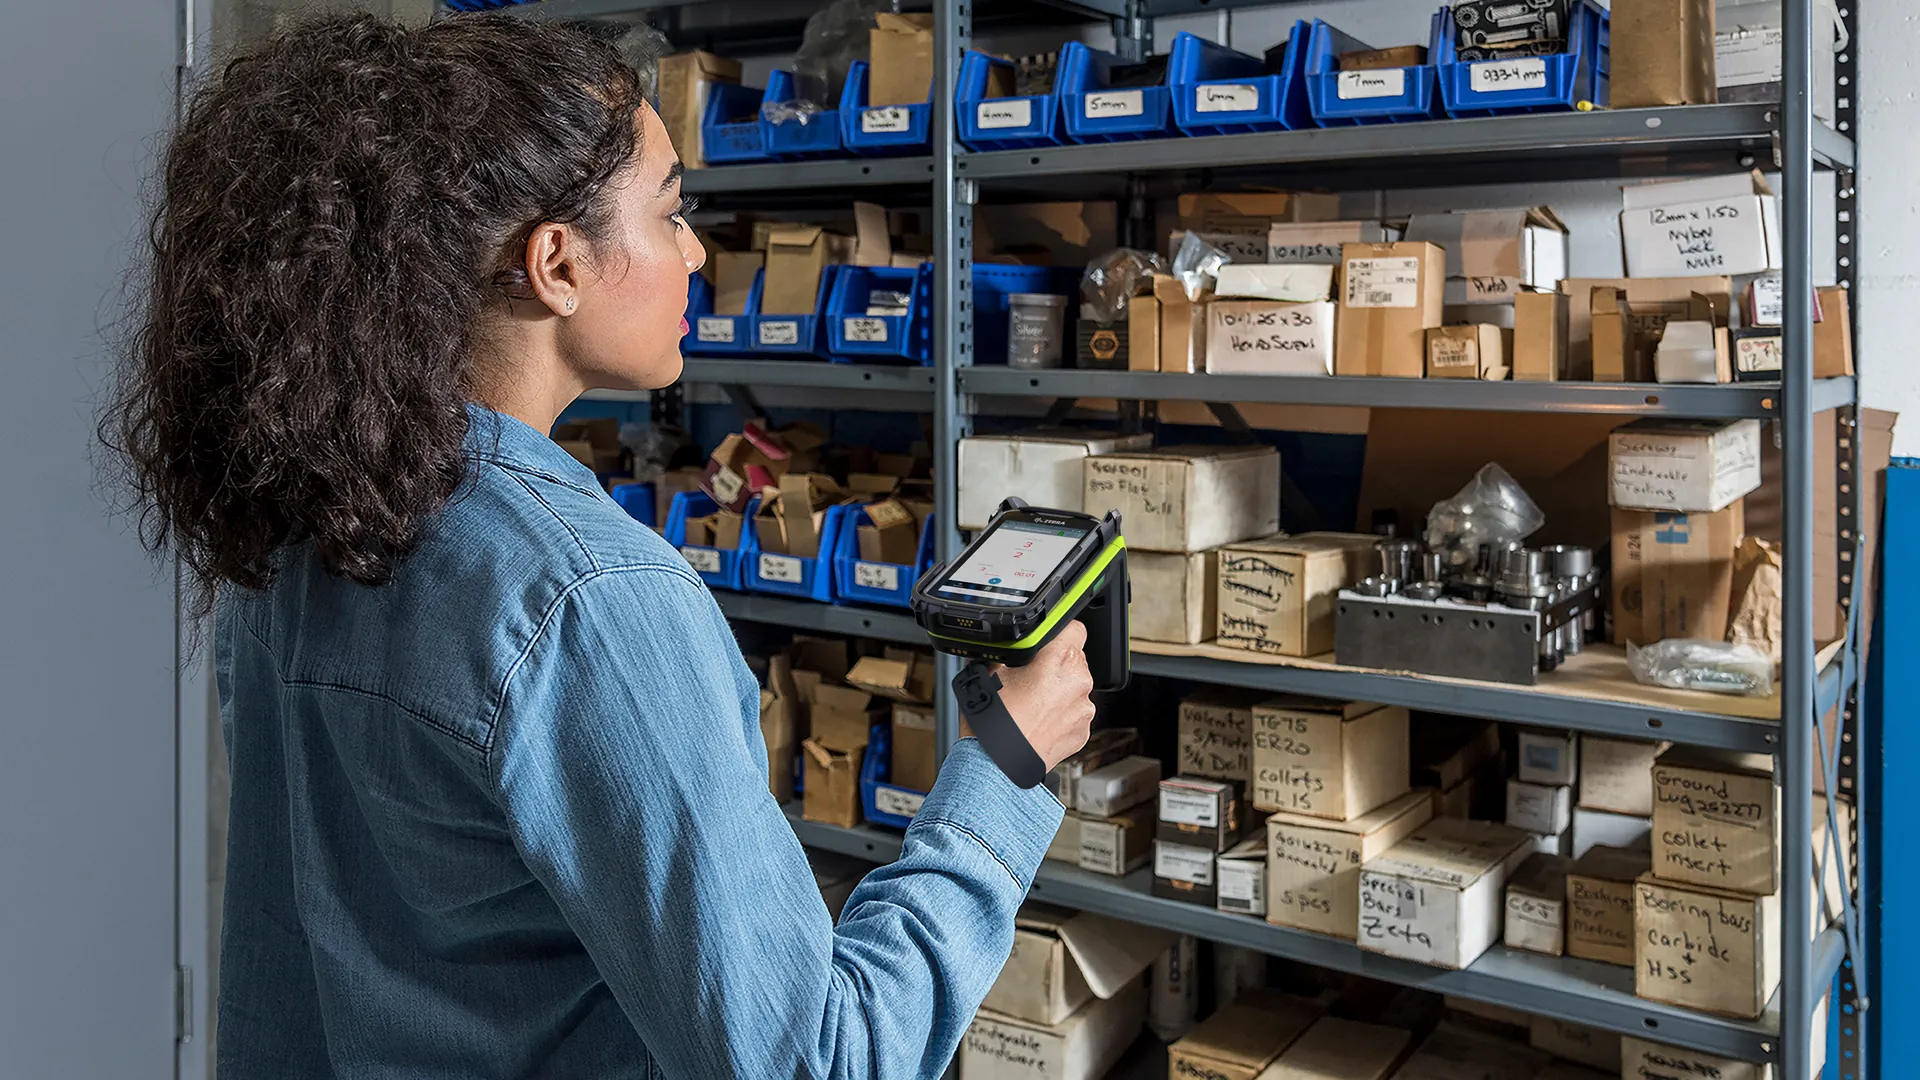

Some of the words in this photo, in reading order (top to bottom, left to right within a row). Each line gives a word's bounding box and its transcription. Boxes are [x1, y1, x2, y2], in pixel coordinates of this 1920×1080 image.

[1043, 518, 1066, 526] ZEBRA
[1013, 551, 1023, 559] 2
[1254, 731, 1312, 756] ER20
[1656, 769, 1729, 800] Ground
